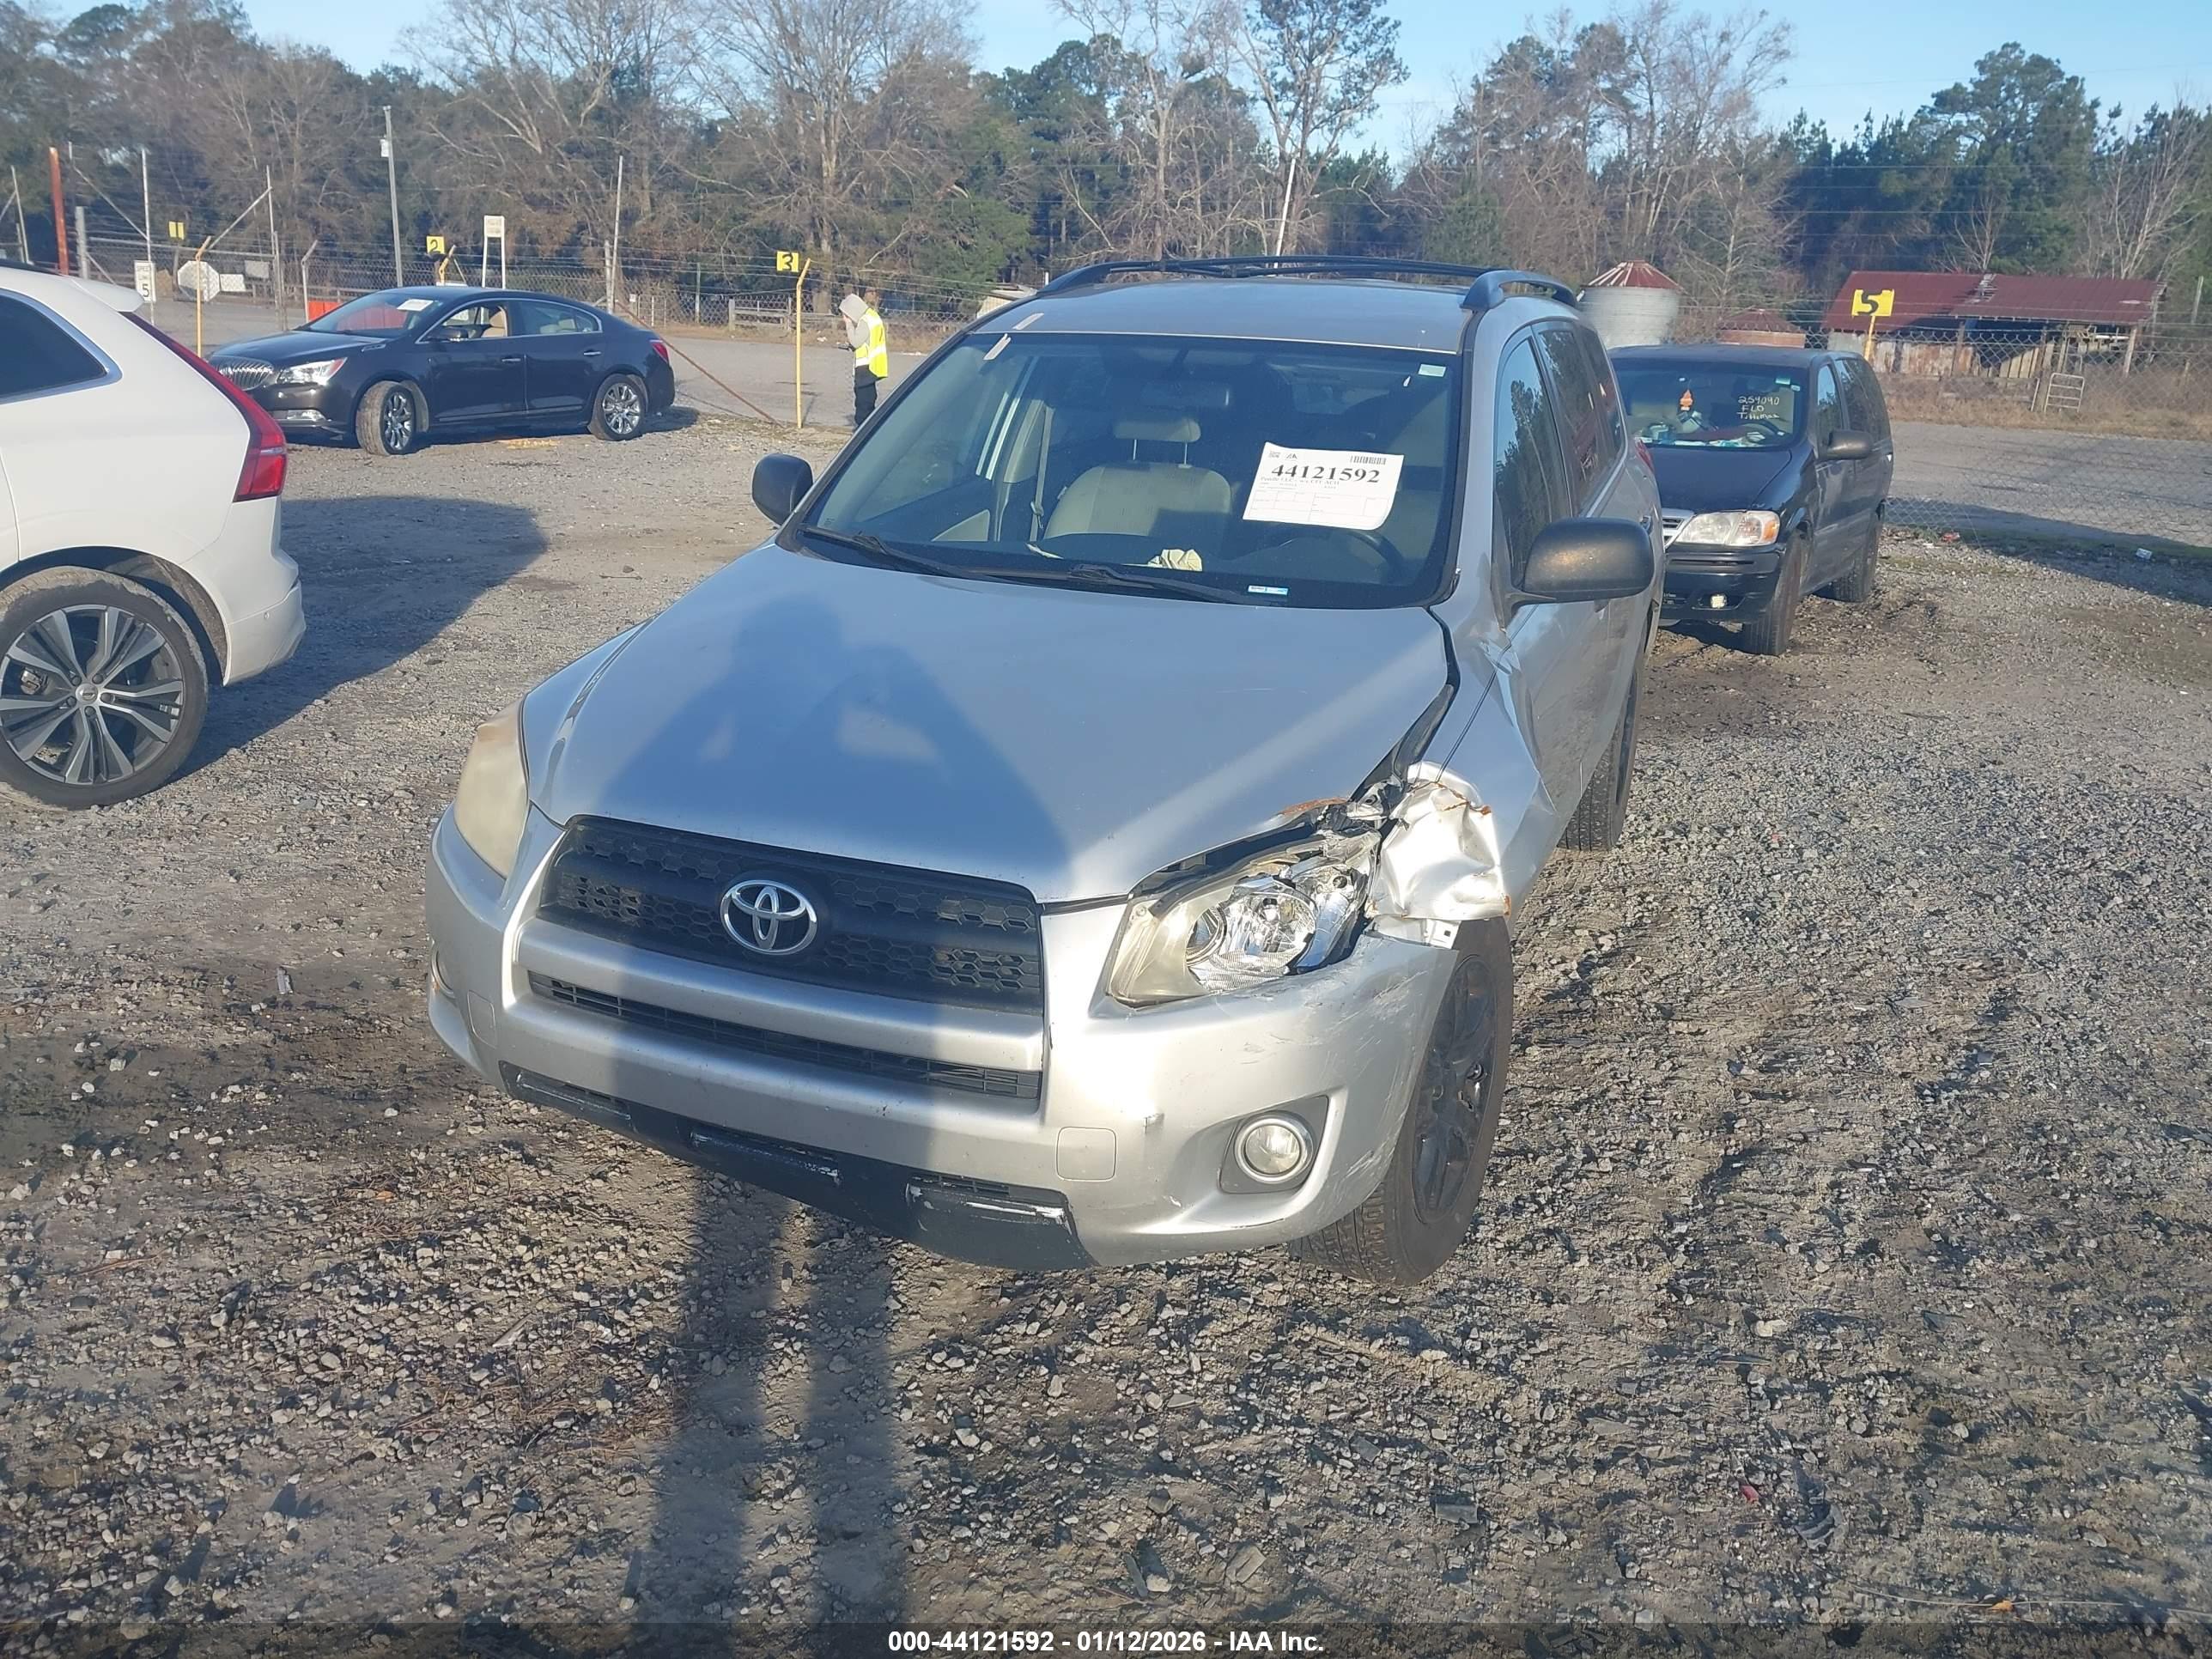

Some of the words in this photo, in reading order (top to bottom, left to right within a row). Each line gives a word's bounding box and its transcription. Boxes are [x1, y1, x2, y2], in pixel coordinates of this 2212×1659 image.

[429, 239, 441, 254] 2
[782, 252, 793, 271] 3
[142, 283, 150, 297] 5
[1856, 288, 1882, 316] 5
[1271, 465, 1381, 483] 44121592
